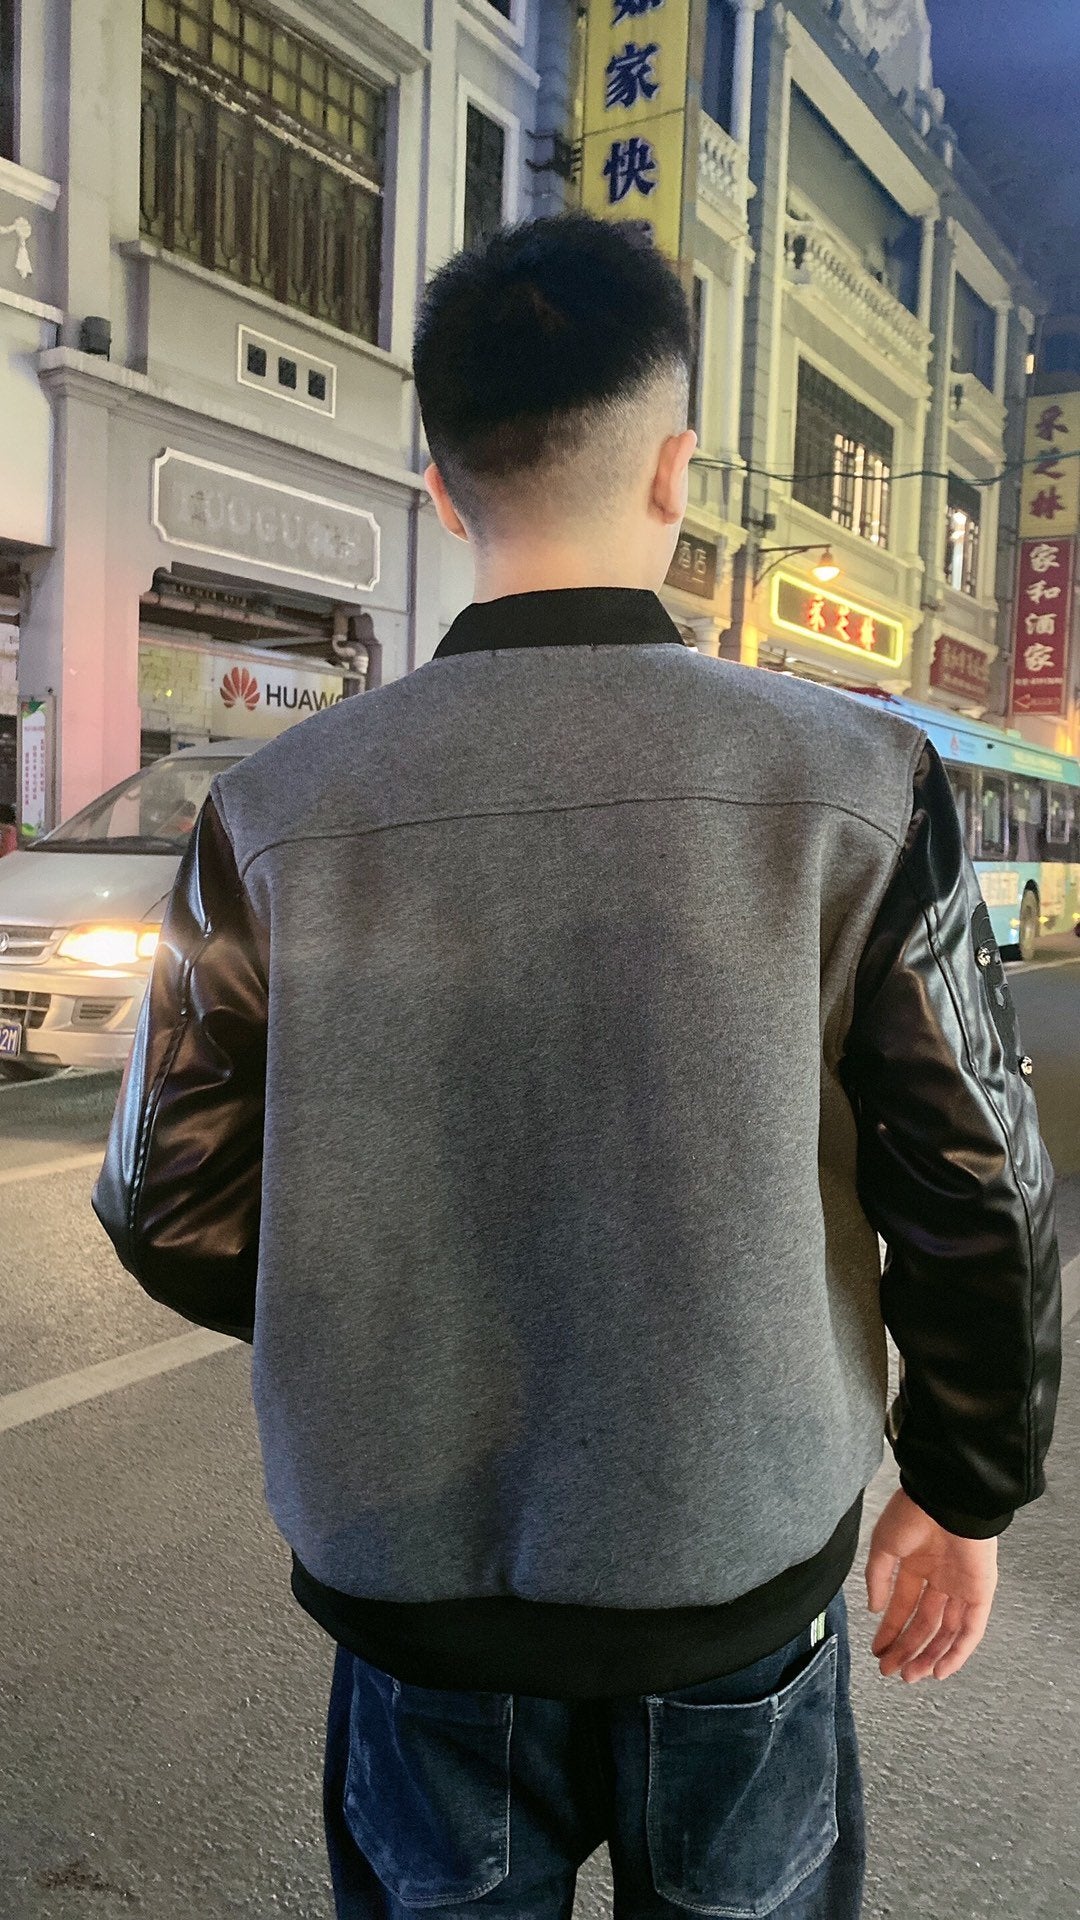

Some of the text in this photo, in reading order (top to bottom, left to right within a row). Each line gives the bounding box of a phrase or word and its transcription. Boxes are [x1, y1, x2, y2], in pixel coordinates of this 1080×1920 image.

[603, 0, 663, 240] 家快
[1023, 543, 1060, 672] 家和酒家
[266, 684, 343, 711] HUAW
[0, 1029, 18, 1051] 2M
